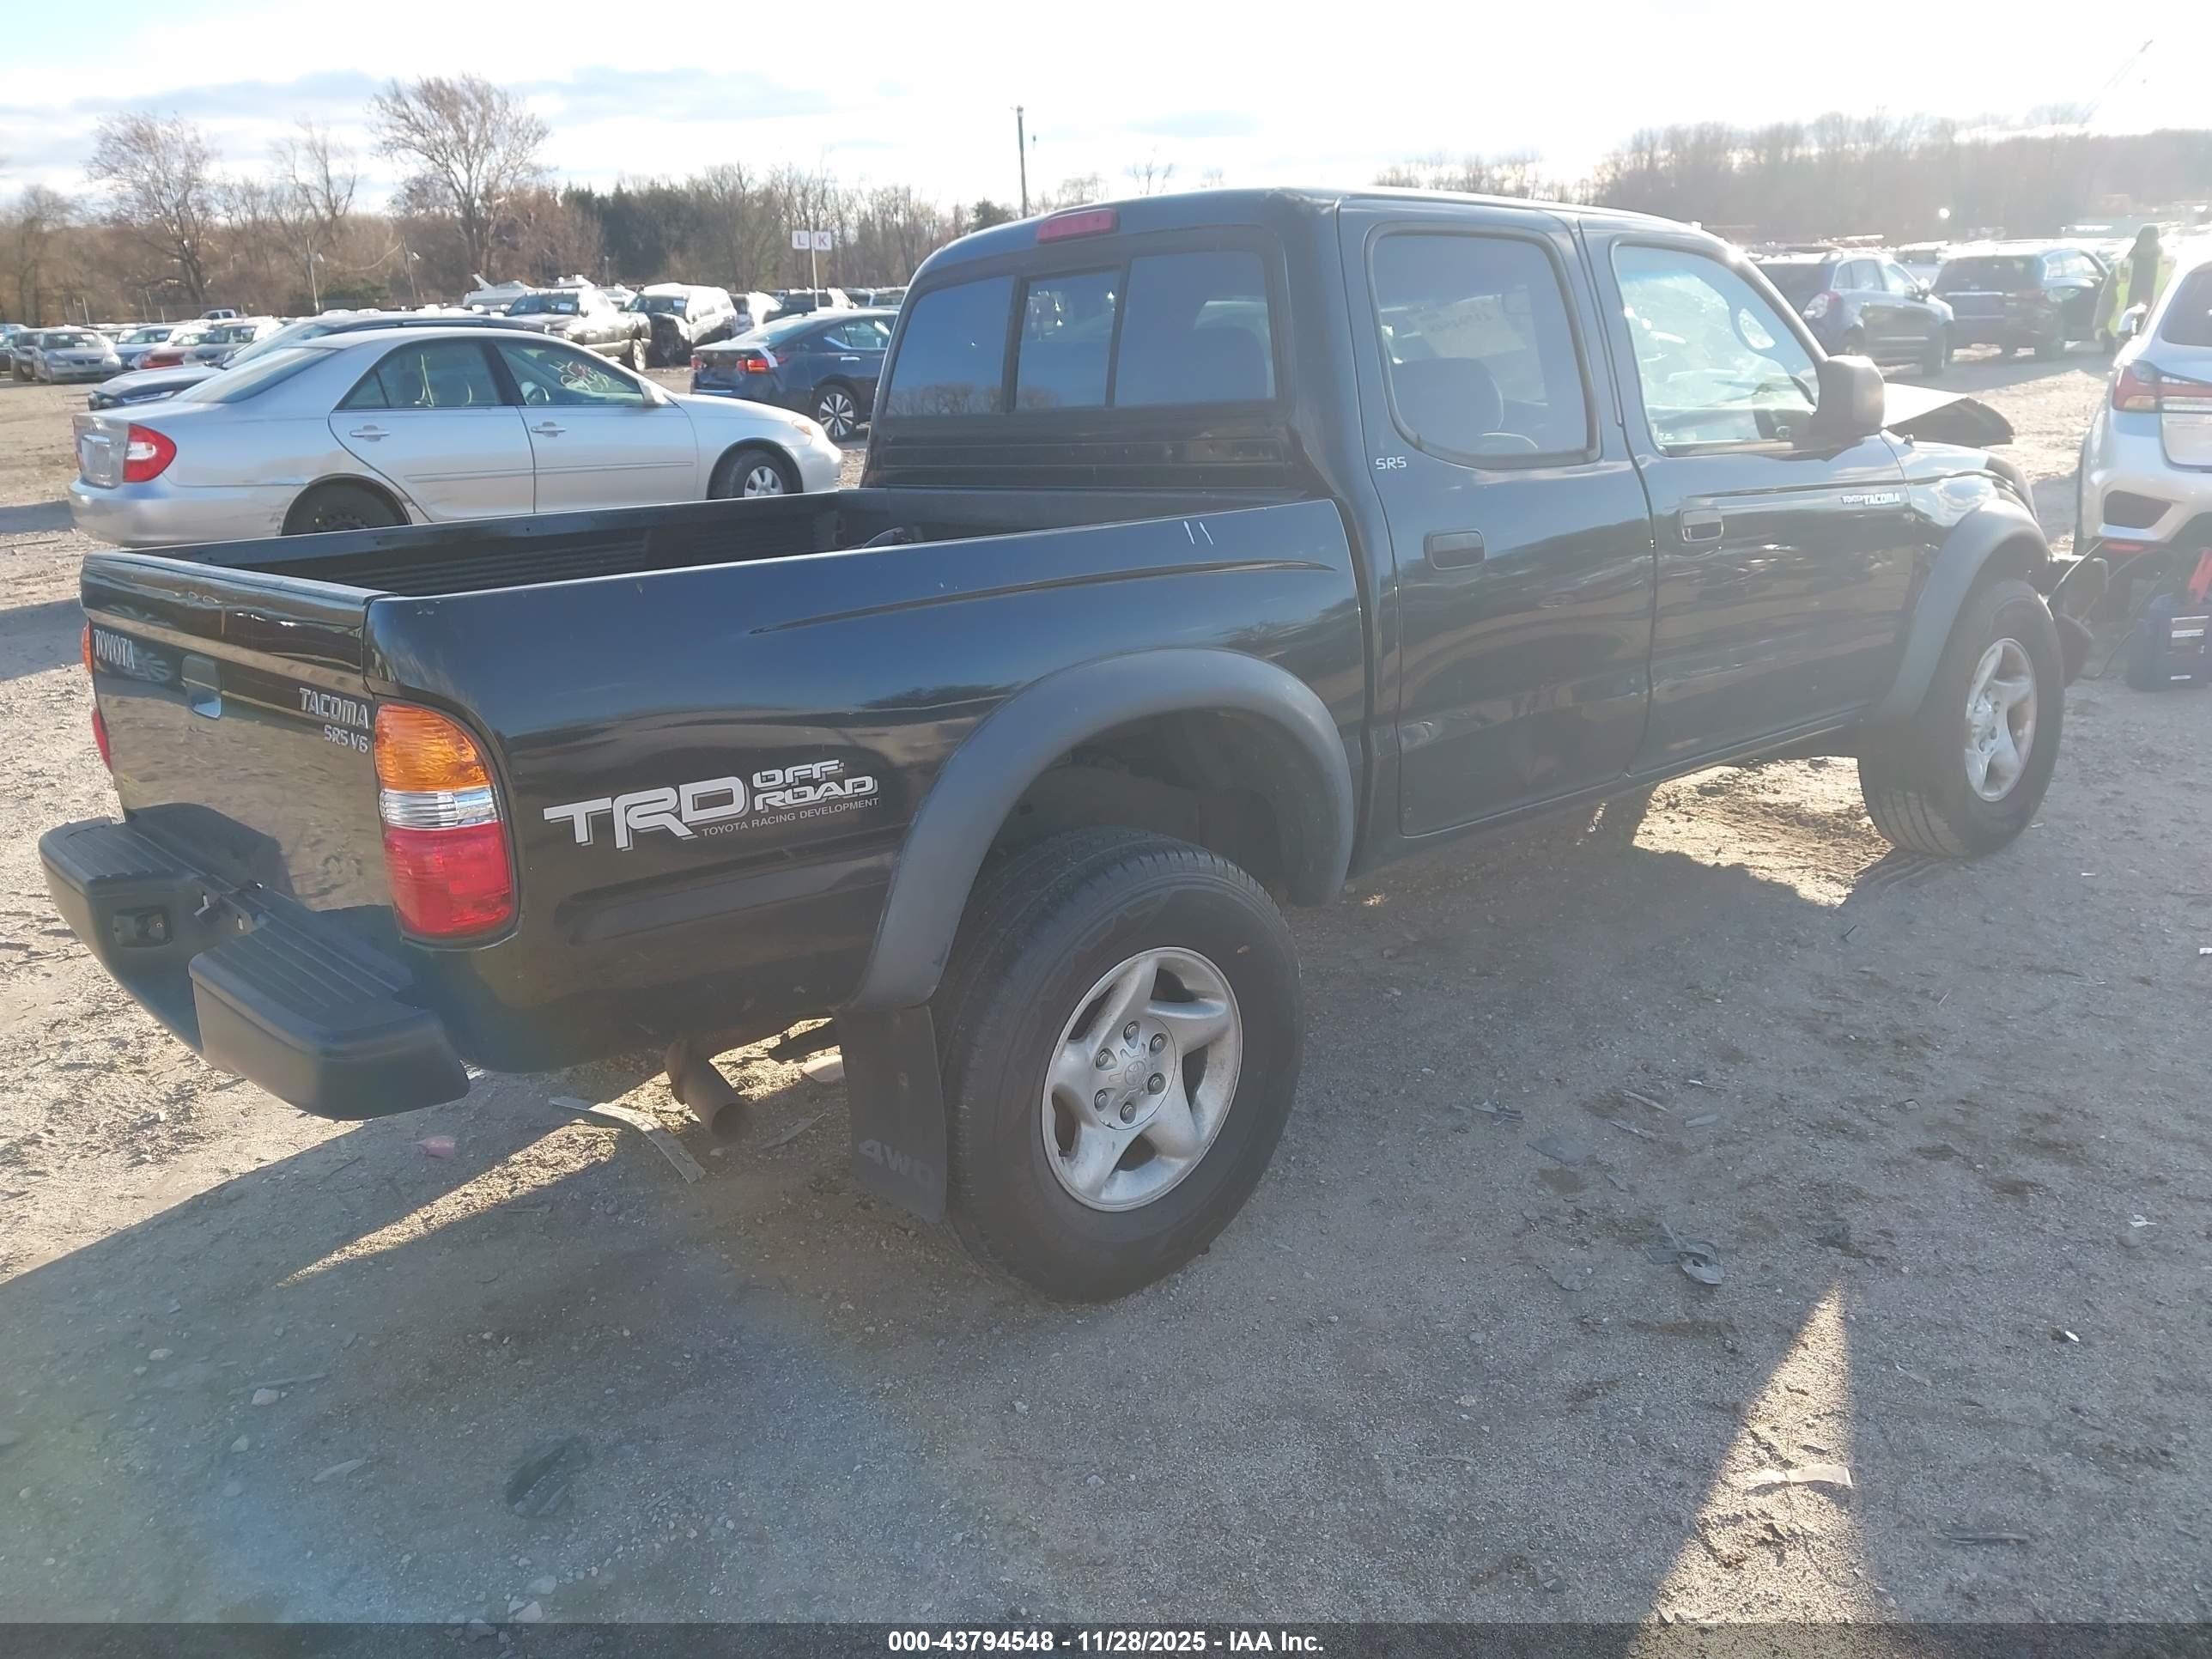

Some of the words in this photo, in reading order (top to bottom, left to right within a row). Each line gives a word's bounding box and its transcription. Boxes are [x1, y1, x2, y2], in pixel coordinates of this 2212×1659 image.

[797, 233, 806, 246] L
[817, 234, 827, 247] K
[1863, 492, 1900, 505] TACOMA
[94, 629, 135, 670] TOYOTA
[298, 687, 369, 730] TACOMA
[324, 724, 349, 746] SR5
[350, 732, 368, 754] V6
[752, 759, 845, 789] OFF
[543, 775, 750, 852] TRD
[754, 775, 878, 814] ROAD
[701, 822, 749, 837] TOYOTA
[751, 812, 797, 829] RACING
[799, 797, 880, 820] DEVELOPMENT
[858, 1139, 935, 1189] 4WD
